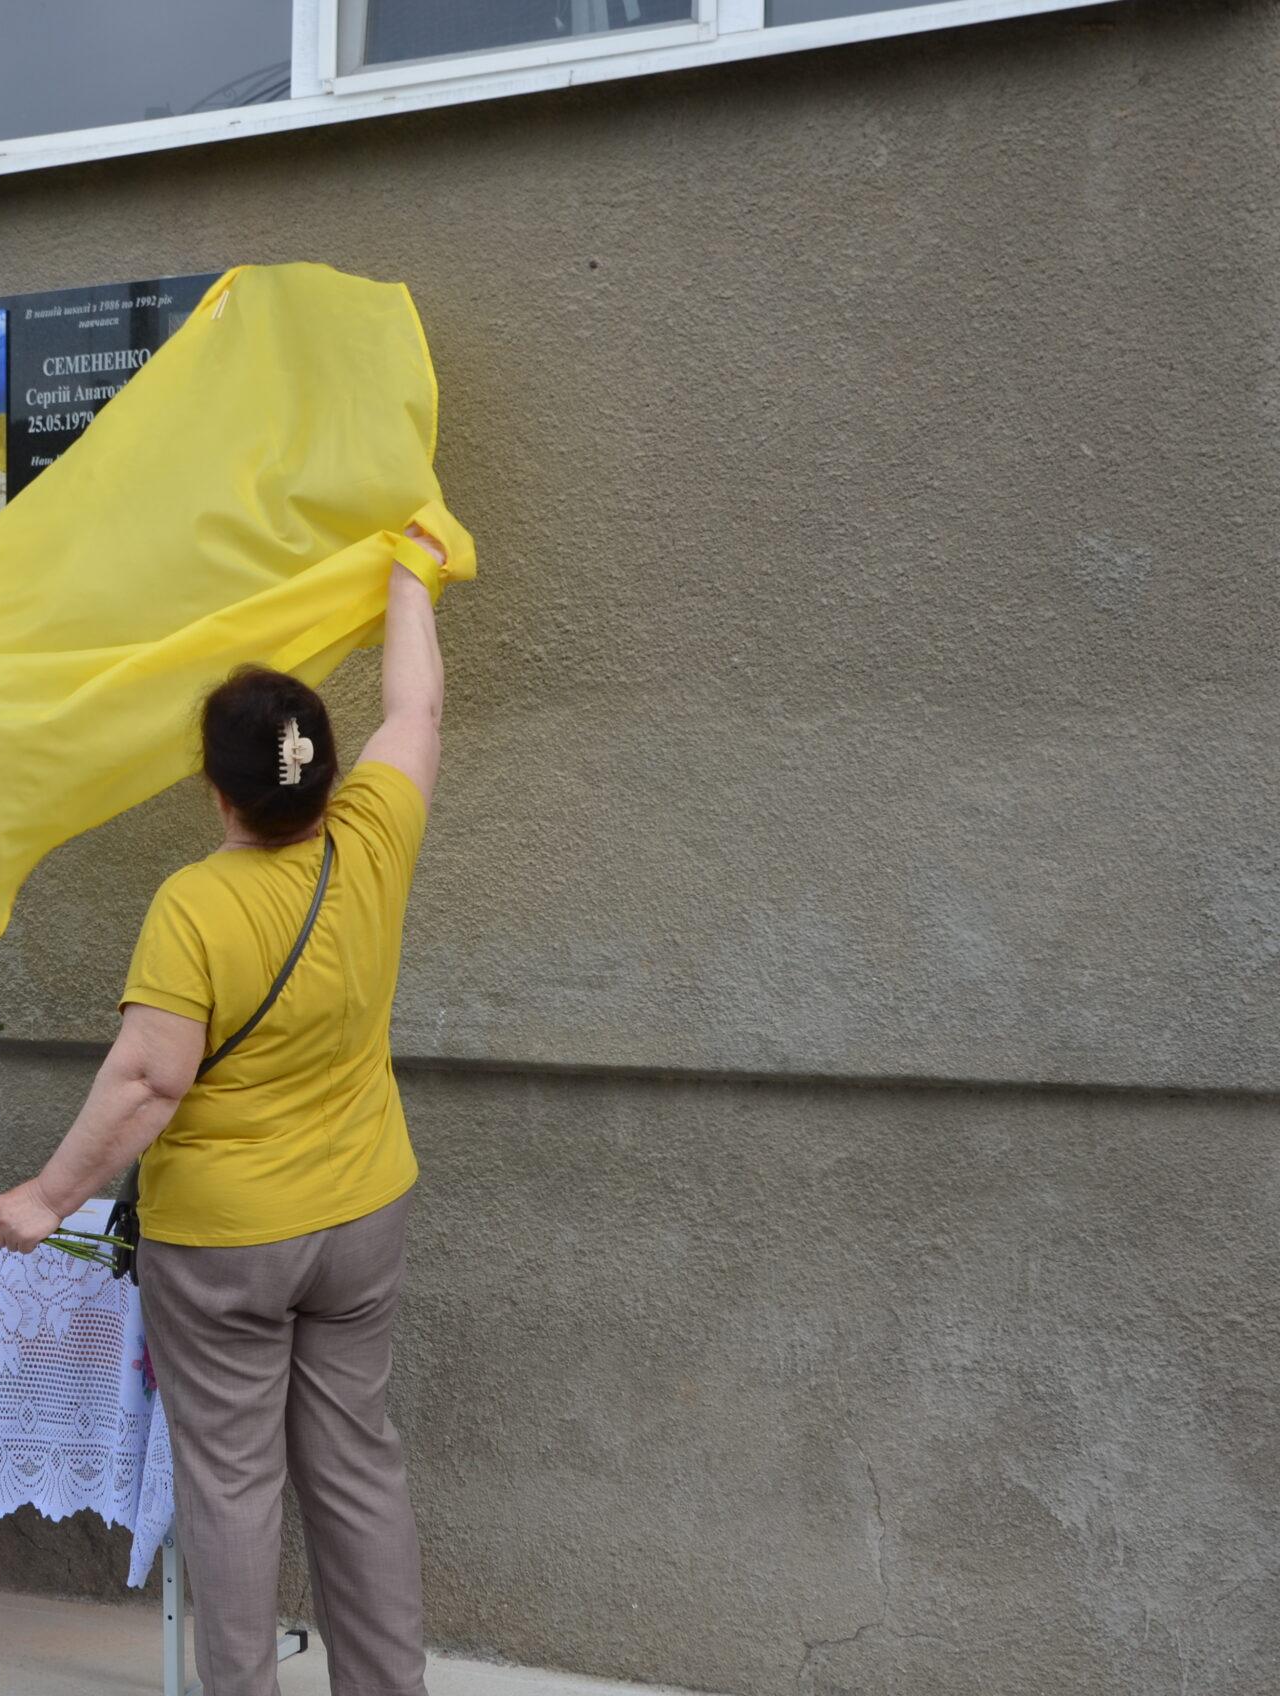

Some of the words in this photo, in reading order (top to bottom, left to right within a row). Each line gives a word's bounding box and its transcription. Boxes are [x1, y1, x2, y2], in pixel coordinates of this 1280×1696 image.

[25, 309, 33, 320] В
[34, 306, 62, 319] нашій
[64, 303, 91, 315] школі
[100, 299, 120, 312] 1986
[121, 299, 134, 310] по
[135, 295, 157, 308] 1992
[157, 294, 173, 308] рік
[78, 316, 120, 329] навчався
[42, 348, 152, 377] СЕМЕНЕНКО
[25, 385, 72, 410] Сергій
[30, 455, 54, 467] Наш
